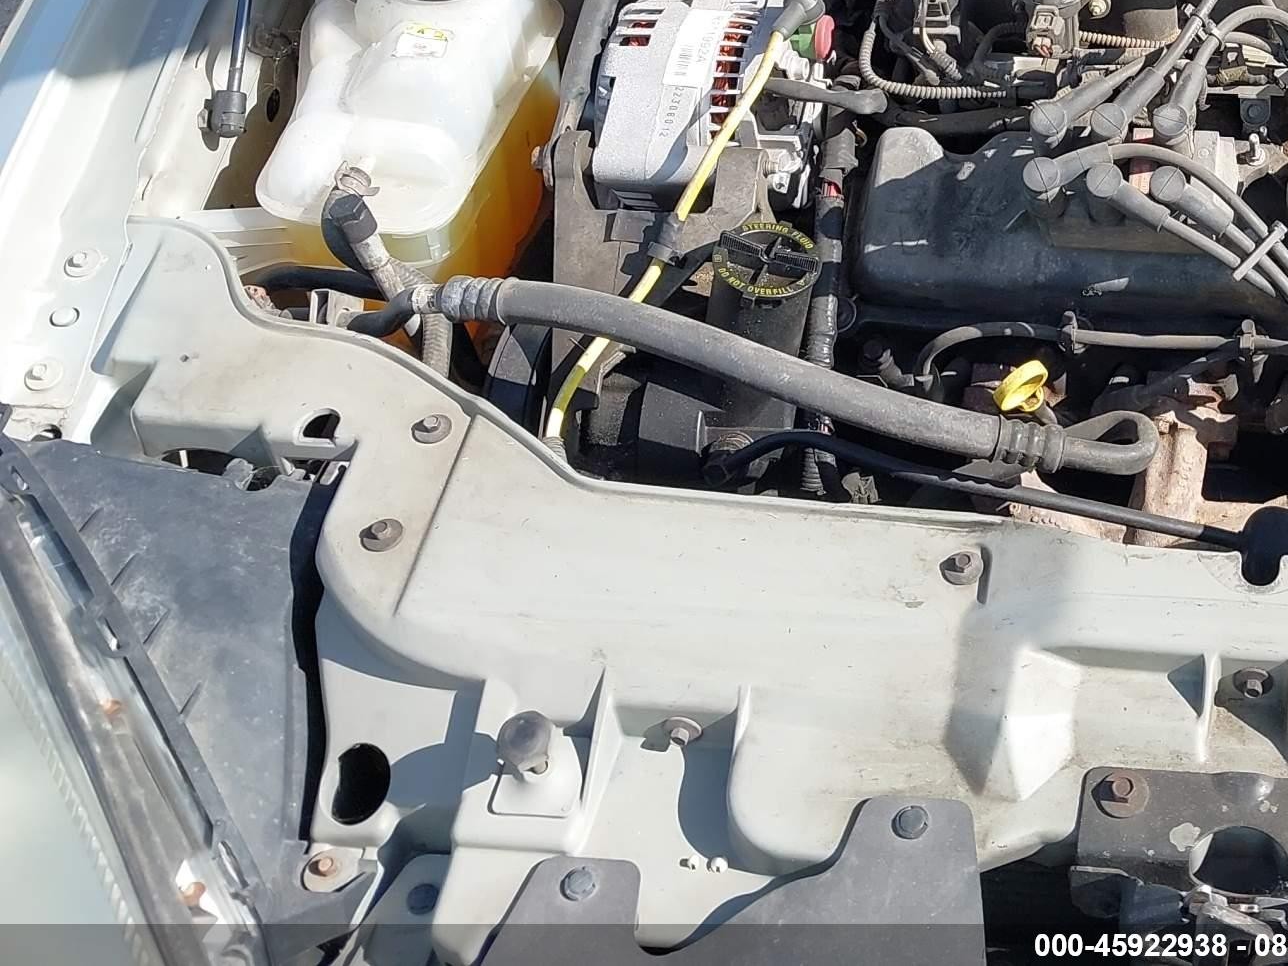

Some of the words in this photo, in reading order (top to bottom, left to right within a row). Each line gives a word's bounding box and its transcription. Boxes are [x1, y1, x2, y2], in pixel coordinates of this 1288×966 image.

[742, 222, 789, 234] STEERING
[791, 230, 814, 250] FLUID
[718, 267, 730, 278] DO
[728, 277, 746, 290] NOT
[747, 285, 794, 295] OVERFILL
